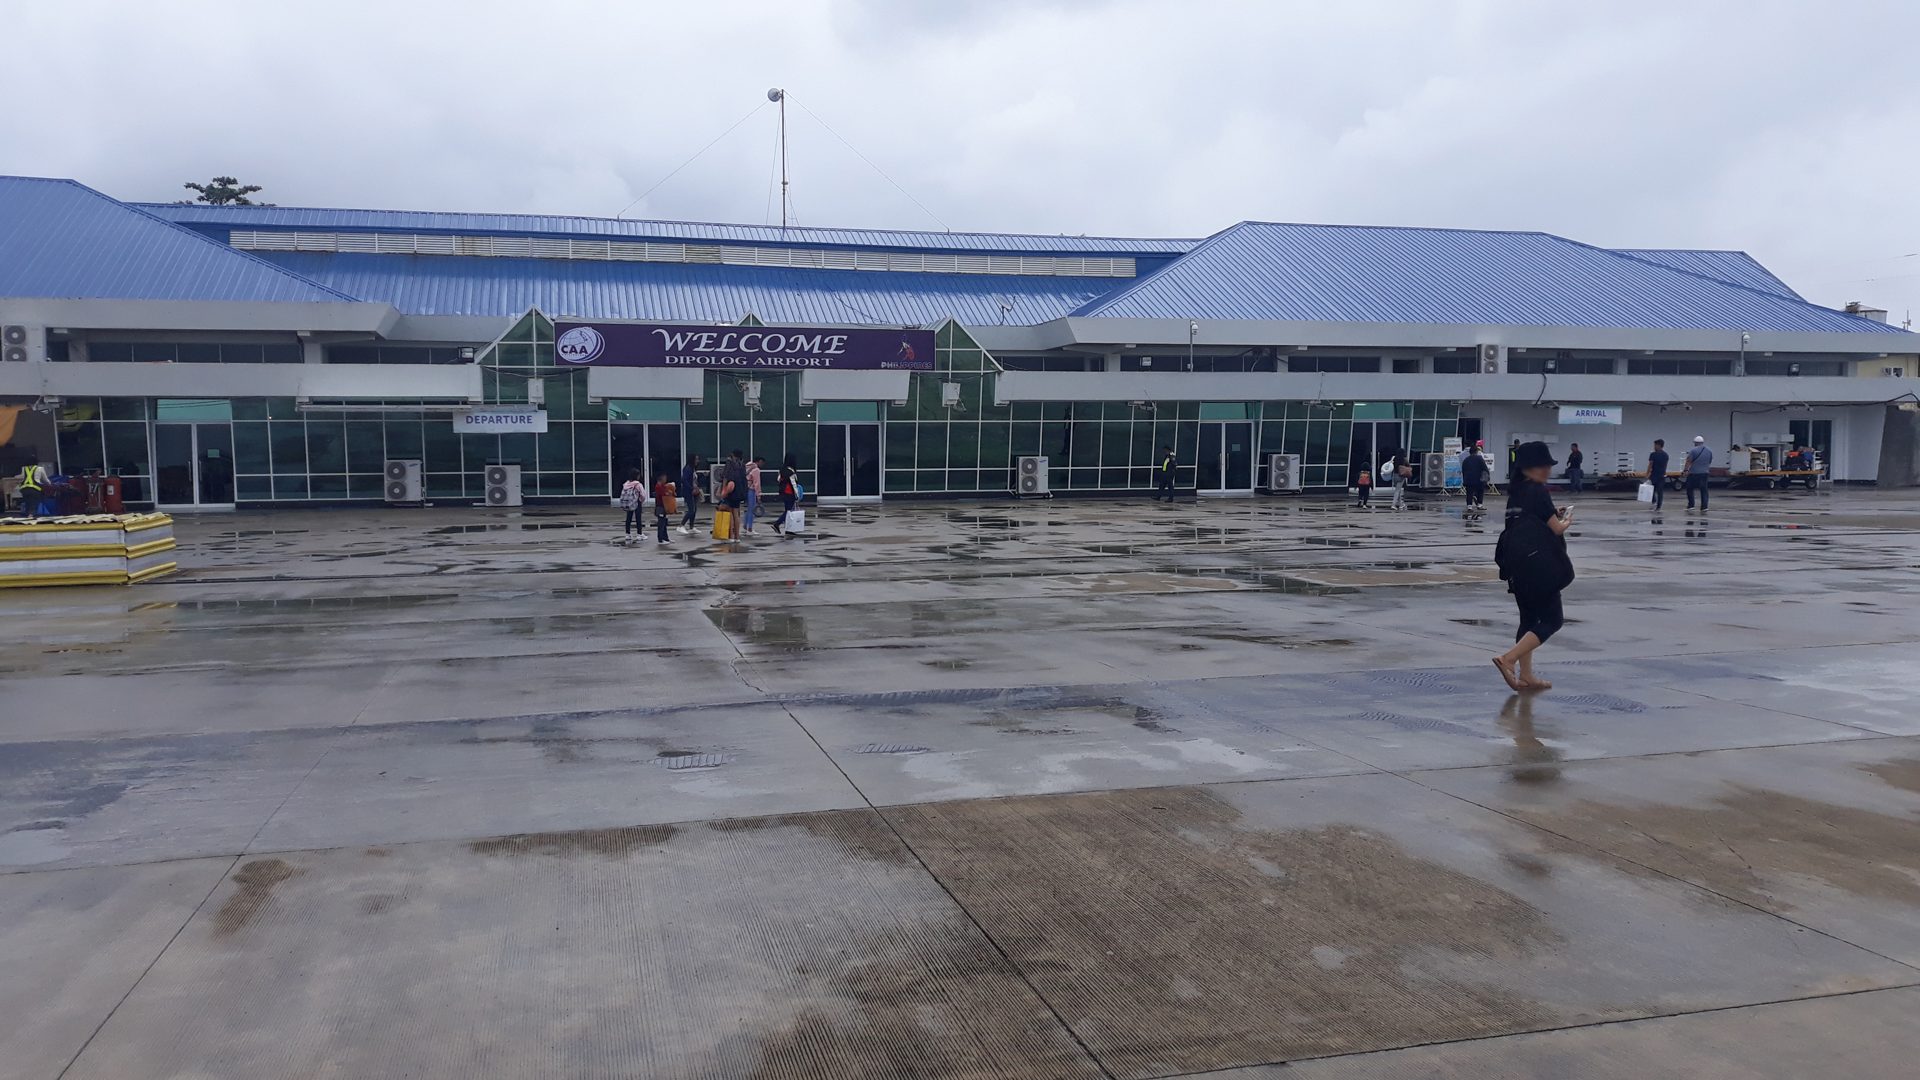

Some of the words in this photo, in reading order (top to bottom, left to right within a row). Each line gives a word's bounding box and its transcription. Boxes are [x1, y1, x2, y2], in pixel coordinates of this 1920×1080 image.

[651, 328, 848, 355] WELCOME
[560, 345, 588, 354] CAA
[665, 355, 748, 365] DIPOLOG
[754, 356, 834, 366] AIRPORT
[1575, 409, 1607, 418] ARRIVAL
[465, 415, 533, 424] DEPARTURE
